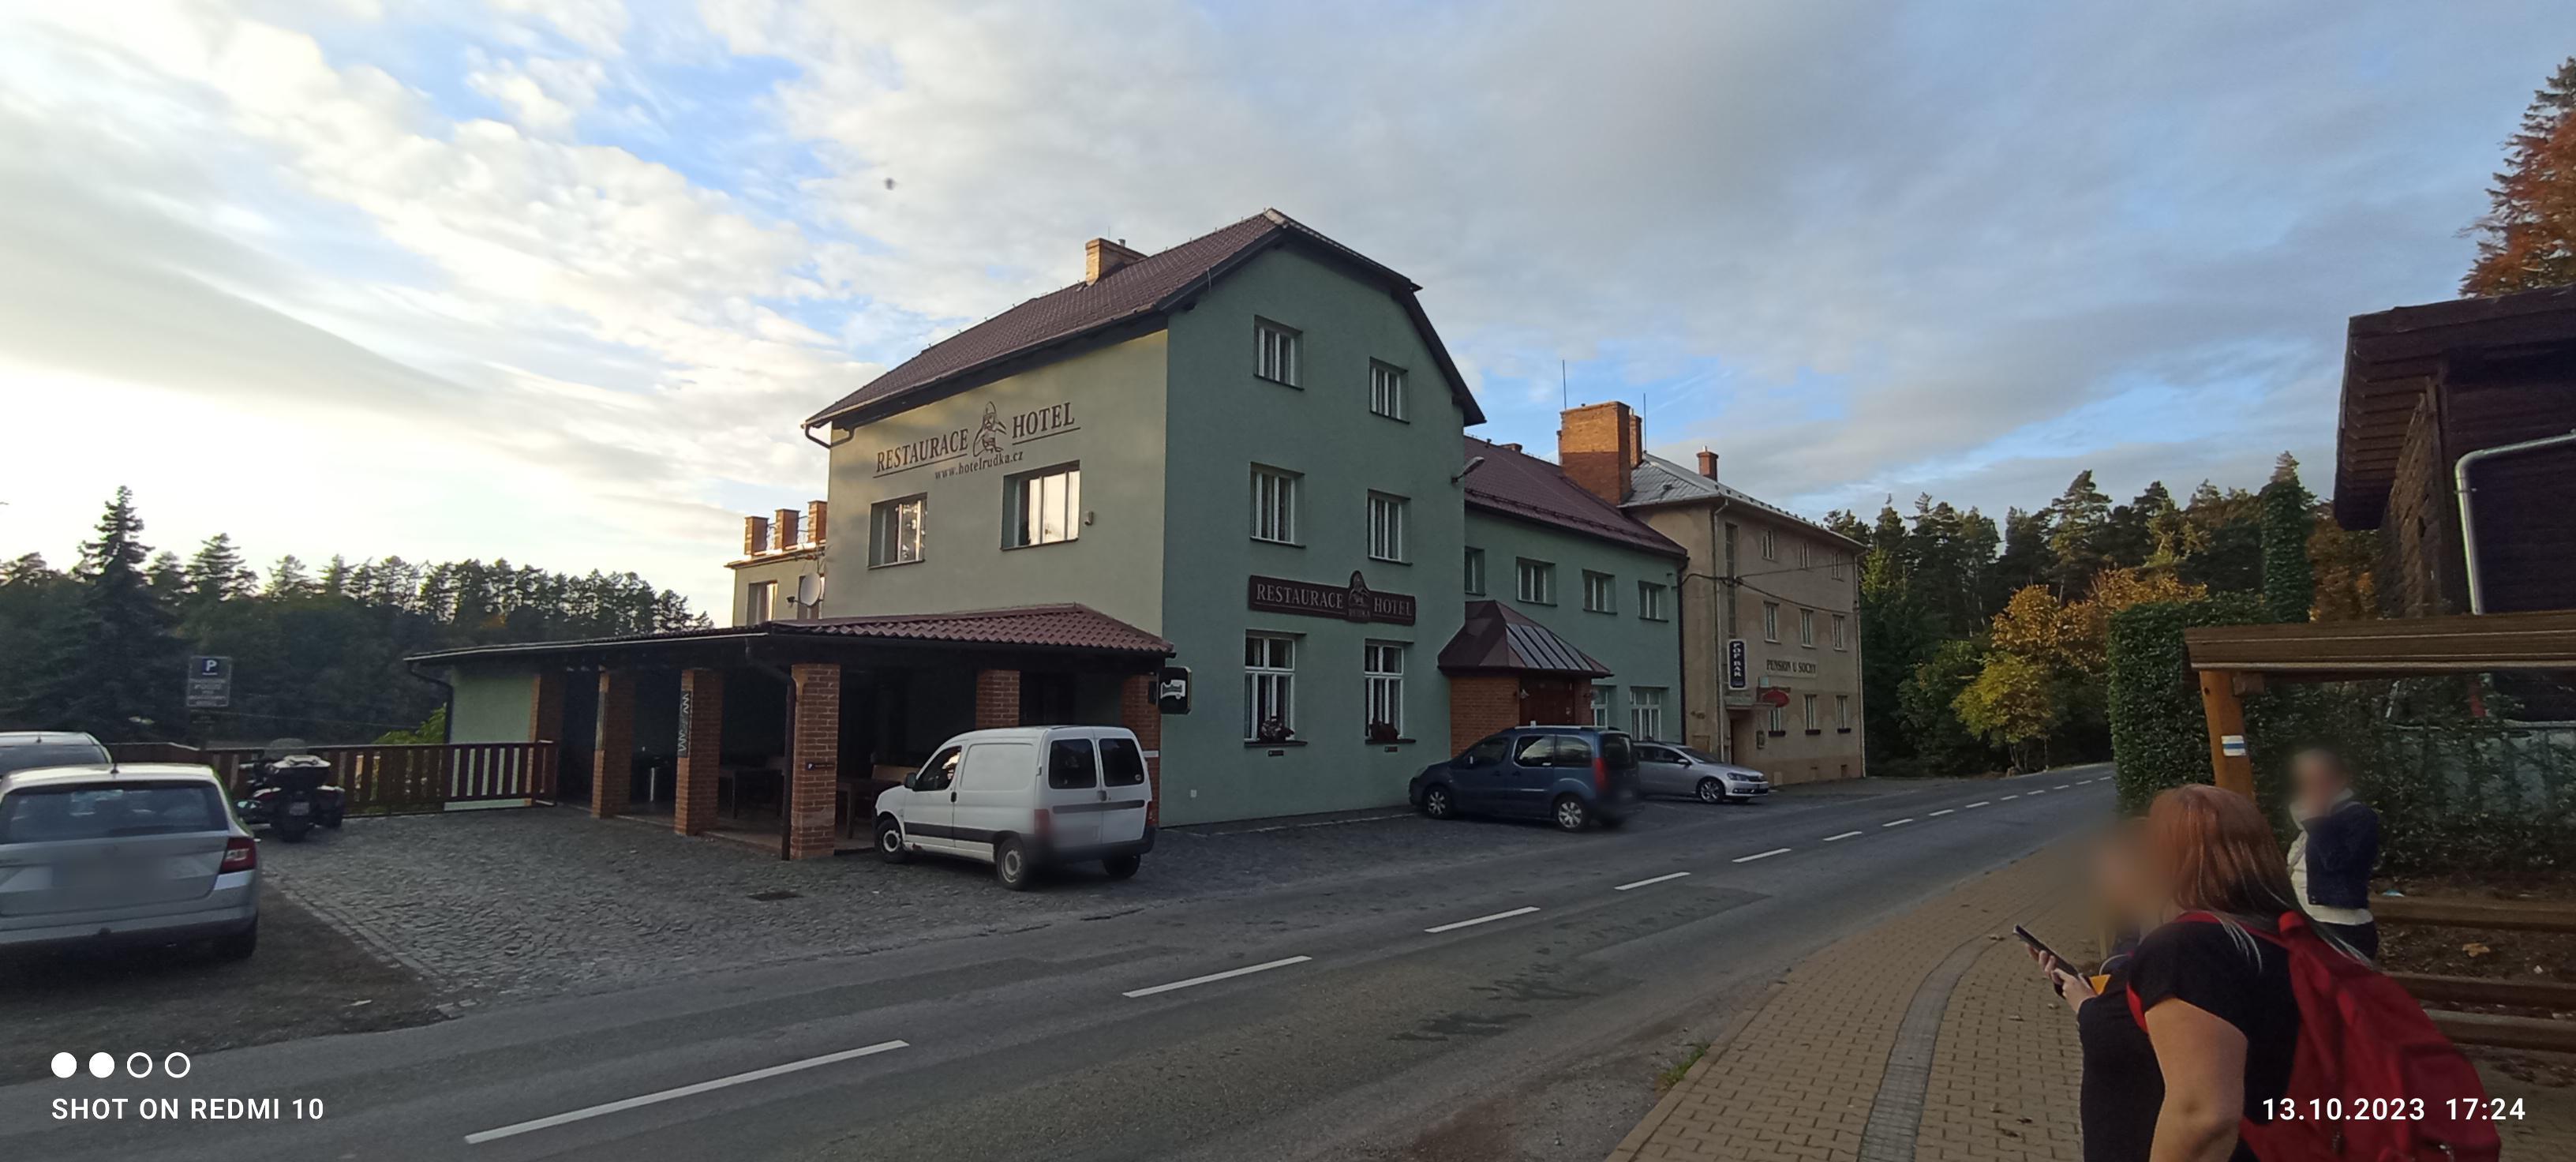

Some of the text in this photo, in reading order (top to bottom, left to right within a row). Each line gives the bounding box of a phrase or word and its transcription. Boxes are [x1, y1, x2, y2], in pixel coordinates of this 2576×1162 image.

[876, 402, 1075, 473] RESTAURACE HOTEL
[934, 451, 1024, 479] www.hotelrudka.cz
[1256, 583, 1413, 617] RESTAURACE HOTEL
[206, 660, 217, 672] P
[1766, 658, 1792, 672] PENSION
[1792, 662, 1797, 673] U
